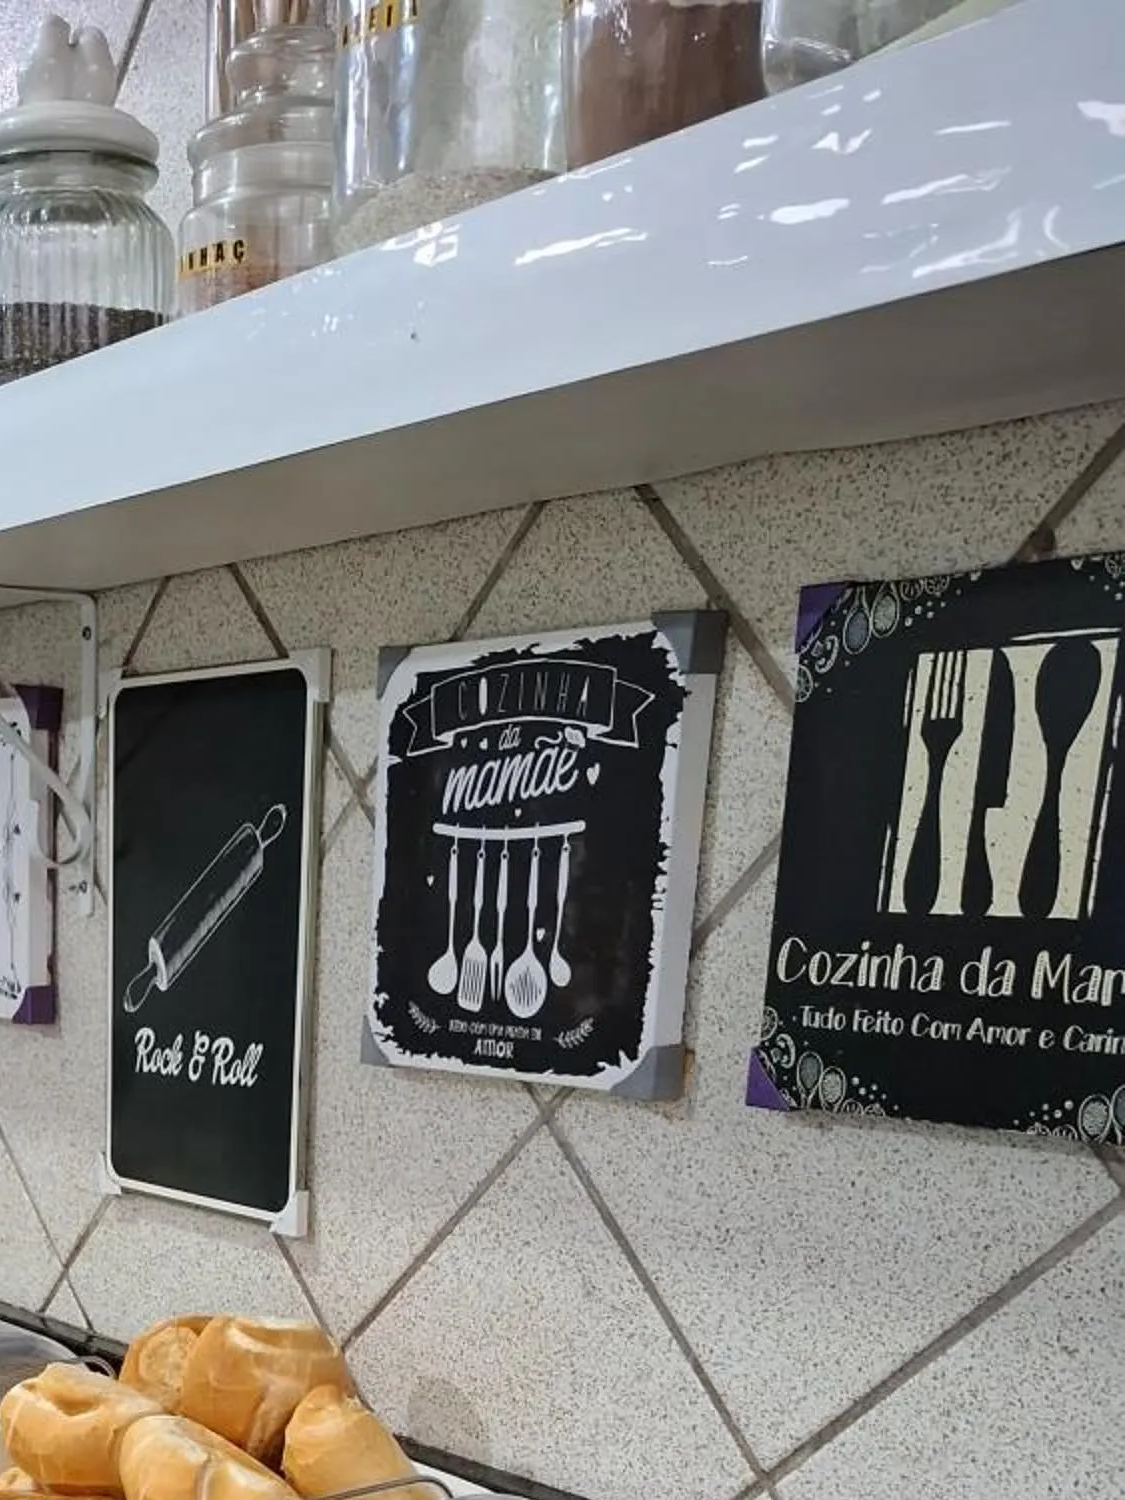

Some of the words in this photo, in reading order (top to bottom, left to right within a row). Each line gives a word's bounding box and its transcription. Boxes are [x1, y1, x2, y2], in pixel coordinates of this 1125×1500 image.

[458, 672, 590, 720] COZINHA
[498, 723, 521, 750] da
[442, 730, 579, 815] mamãe
[776, 936, 944, 993] Cozinha
[960, 946, 1016, 997] da
[474, 1037, 514, 1059] AMOR
[800, 1004, 846, 1031] Tudo
[852, 1008, 904, 1037] Feito
[910, 1012, 961, 1042] Com
[965, 1016, 1031, 1047] Amor
[1038, 1027, 1055, 1050] e
[134, 1026, 184, 1077] Rock
[211, 1036, 264, 1088] Roll
